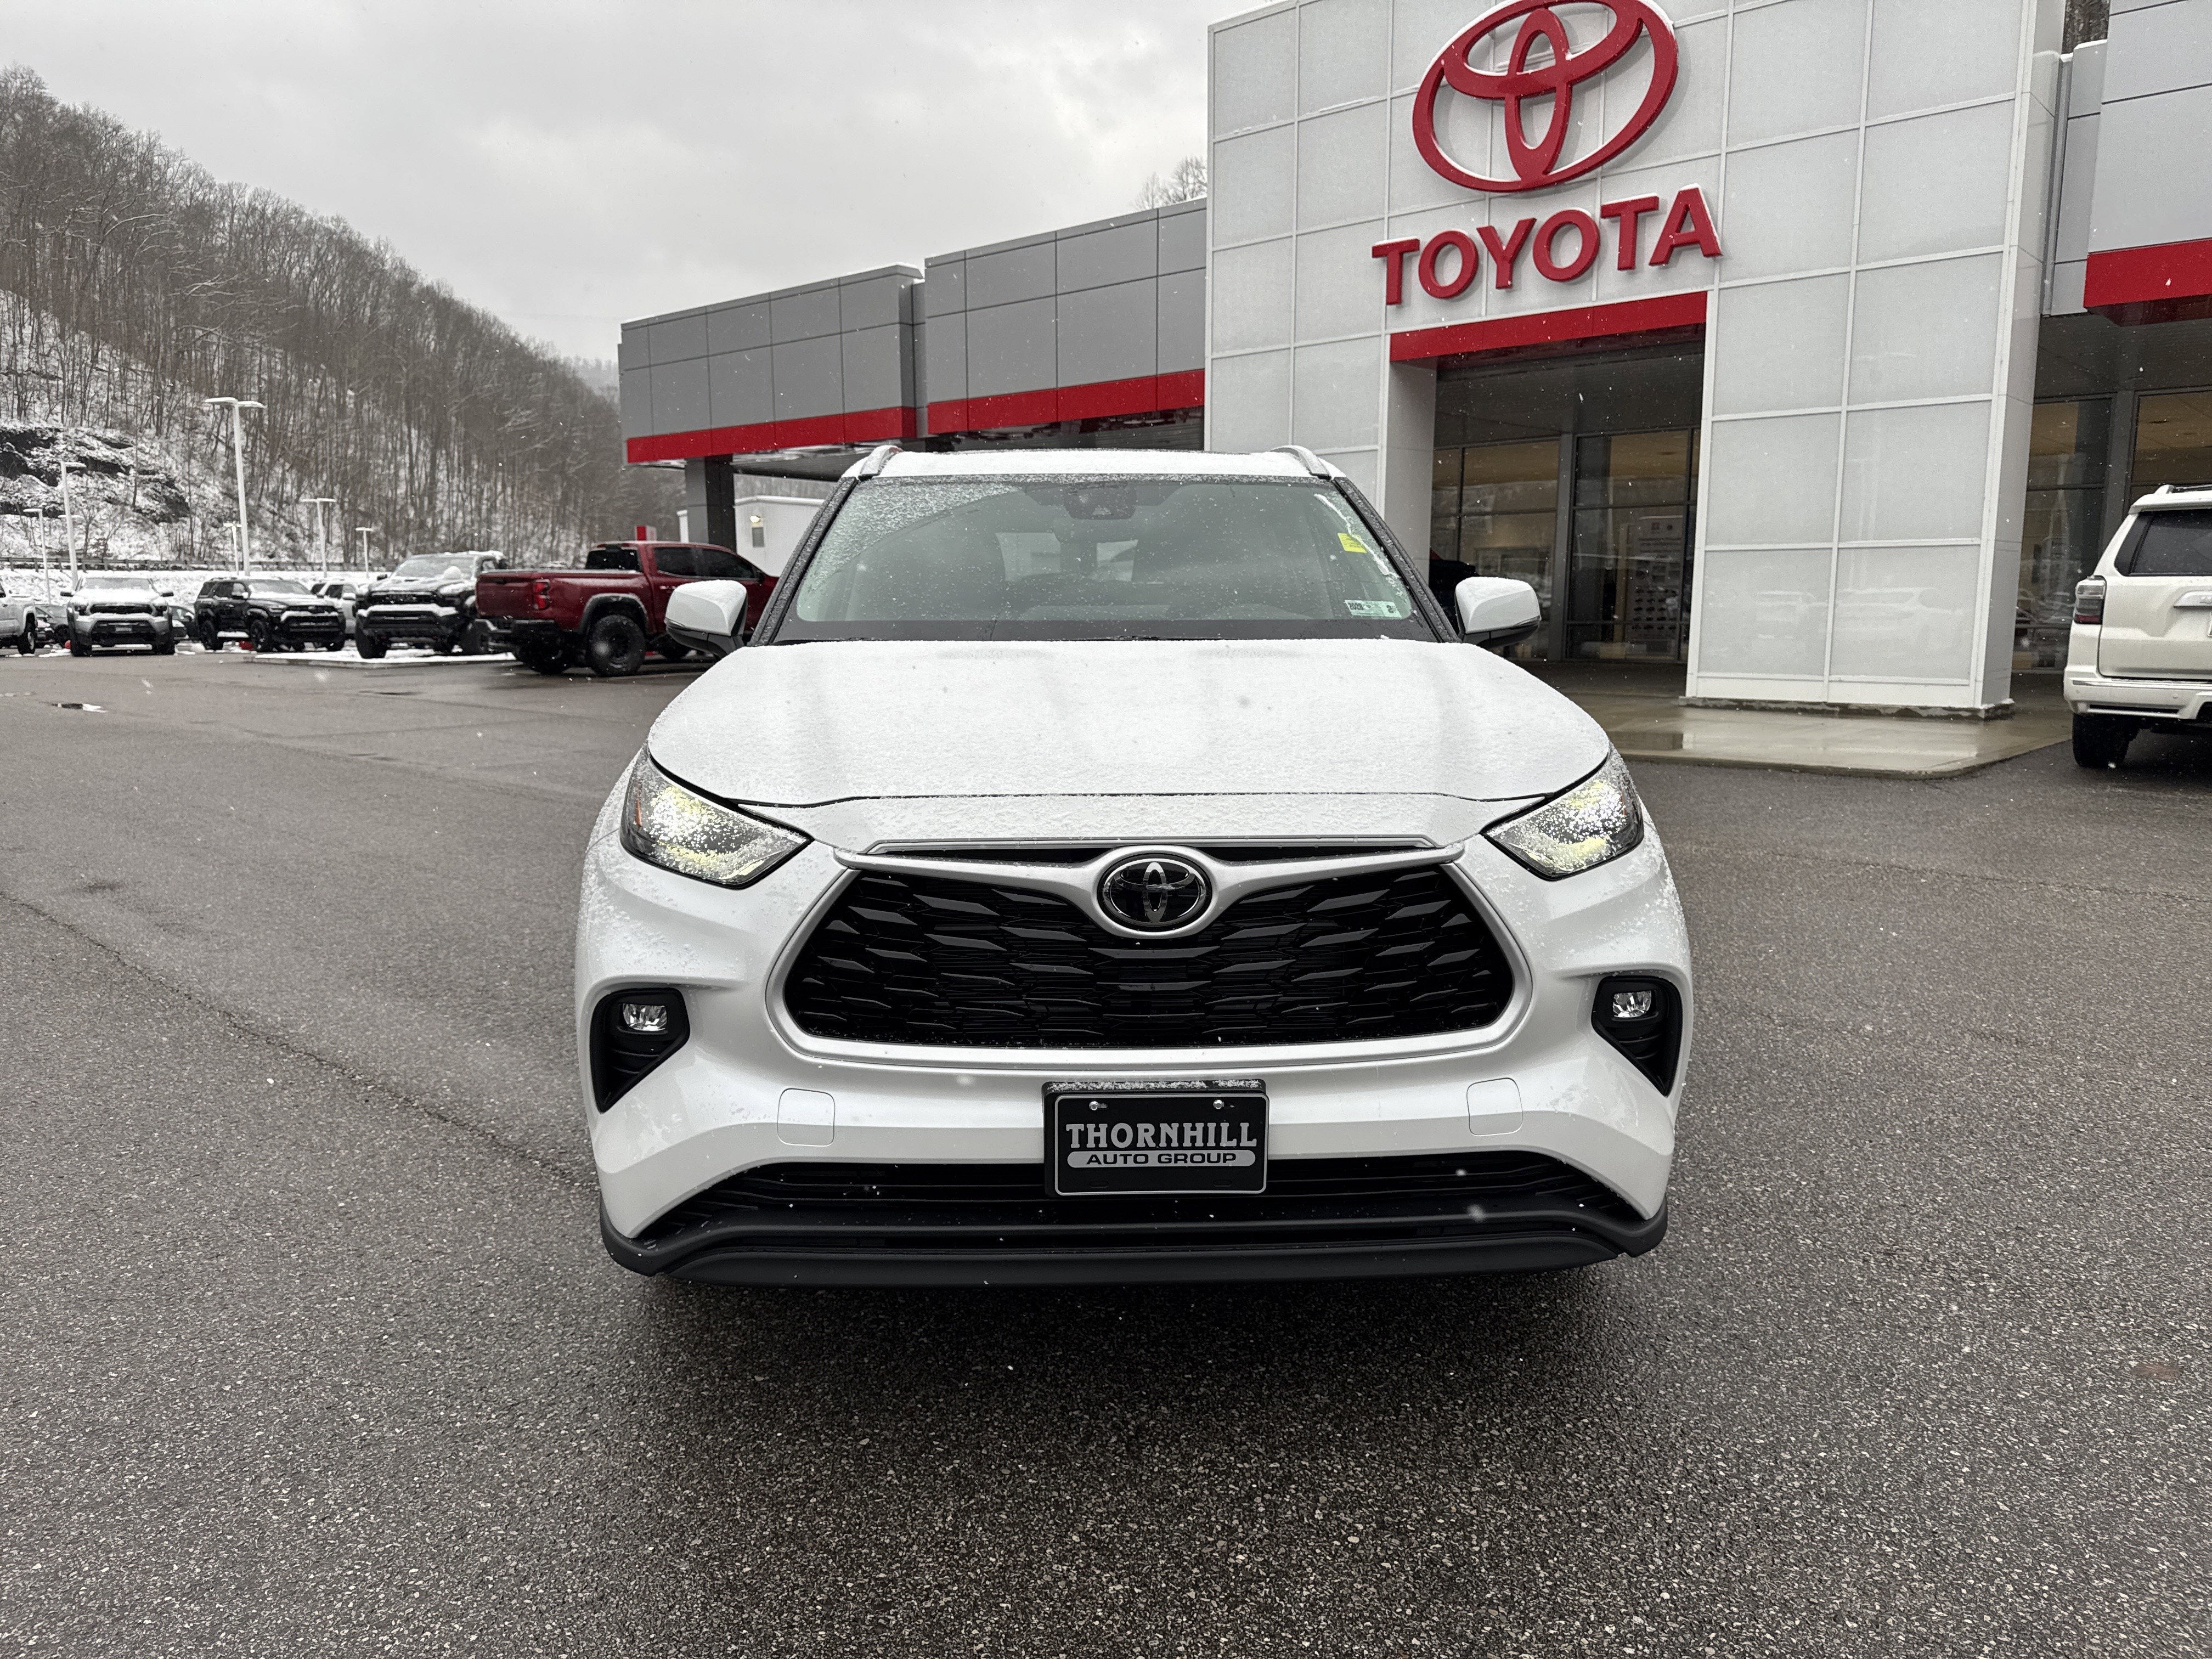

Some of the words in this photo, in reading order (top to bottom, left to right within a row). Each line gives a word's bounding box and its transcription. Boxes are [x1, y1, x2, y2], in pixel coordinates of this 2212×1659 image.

[1372, 184, 1723, 306] TOYOTA
[1065, 1122, 1257, 1148] THORNHILL
[1086, 1153, 1149, 1165] AUTO
[1157, 1153, 1237, 1164] GROUP
